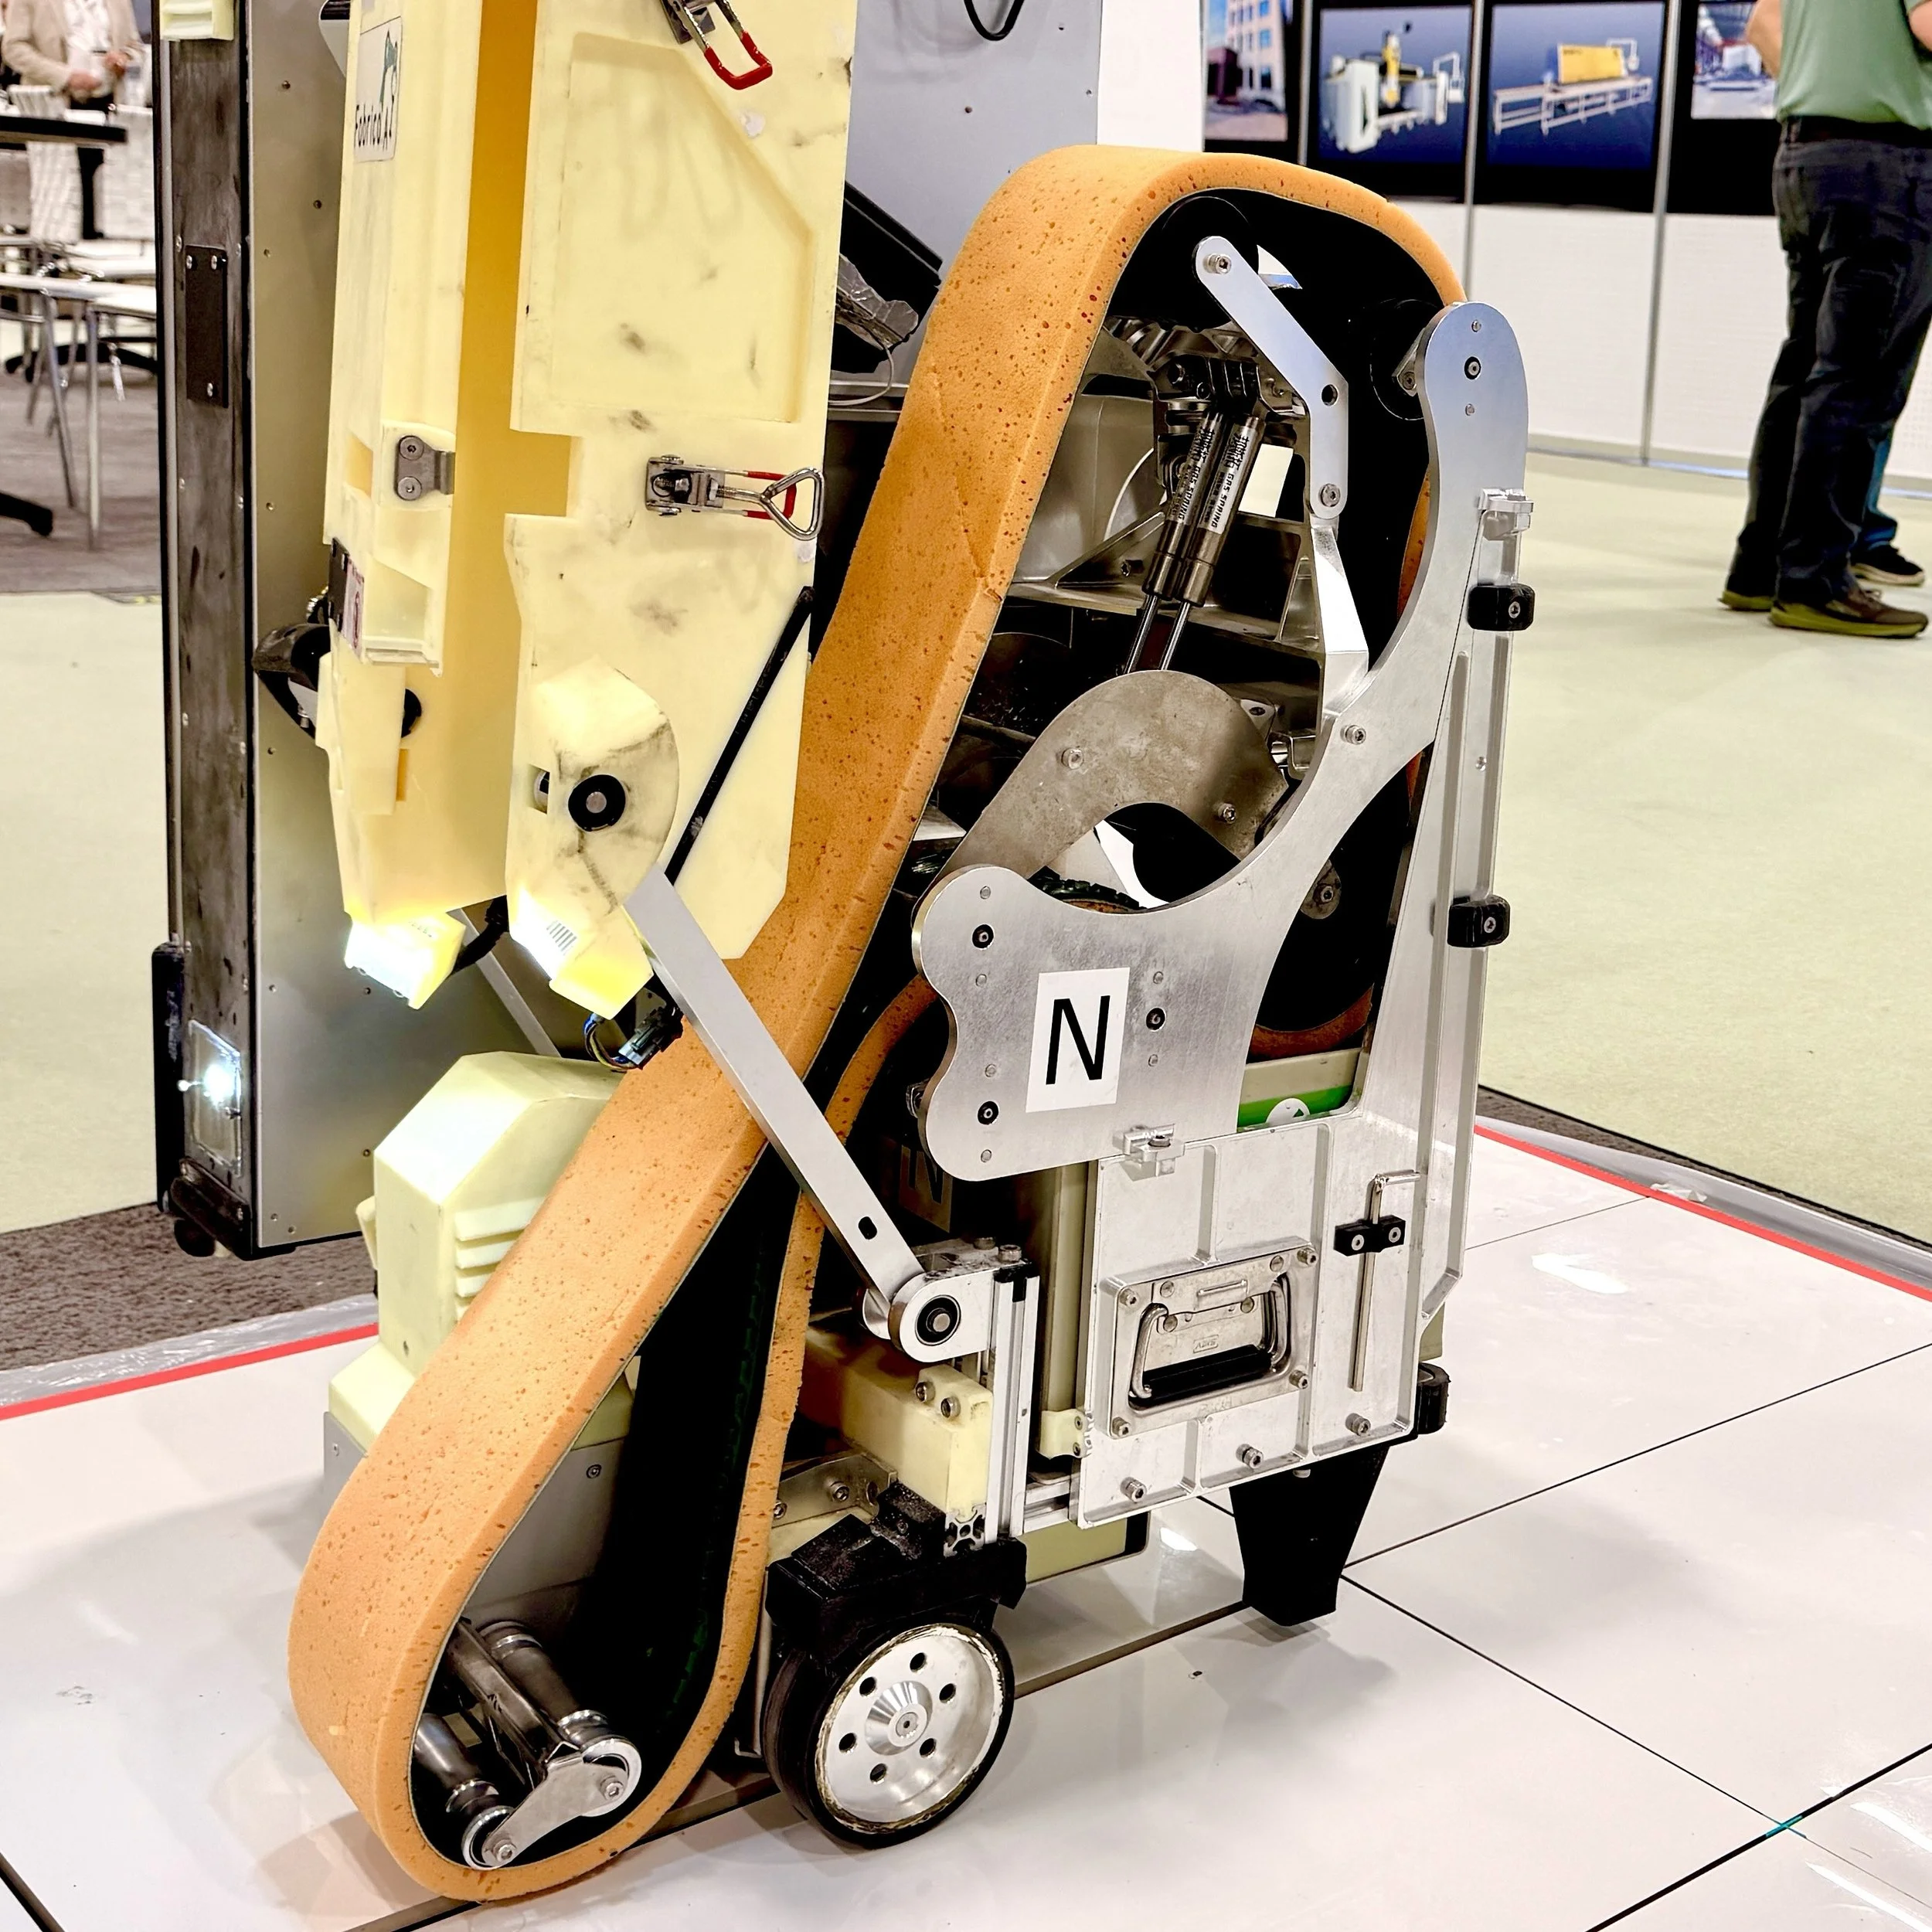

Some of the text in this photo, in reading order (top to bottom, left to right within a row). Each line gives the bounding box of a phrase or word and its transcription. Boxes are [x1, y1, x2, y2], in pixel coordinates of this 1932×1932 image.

[1223, 473, 1235, 493] GAS
[1178, 487, 1195, 521] SPRING
[1210, 494, 1228, 529] SPRING
[1046, 995, 1111, 1085] N
